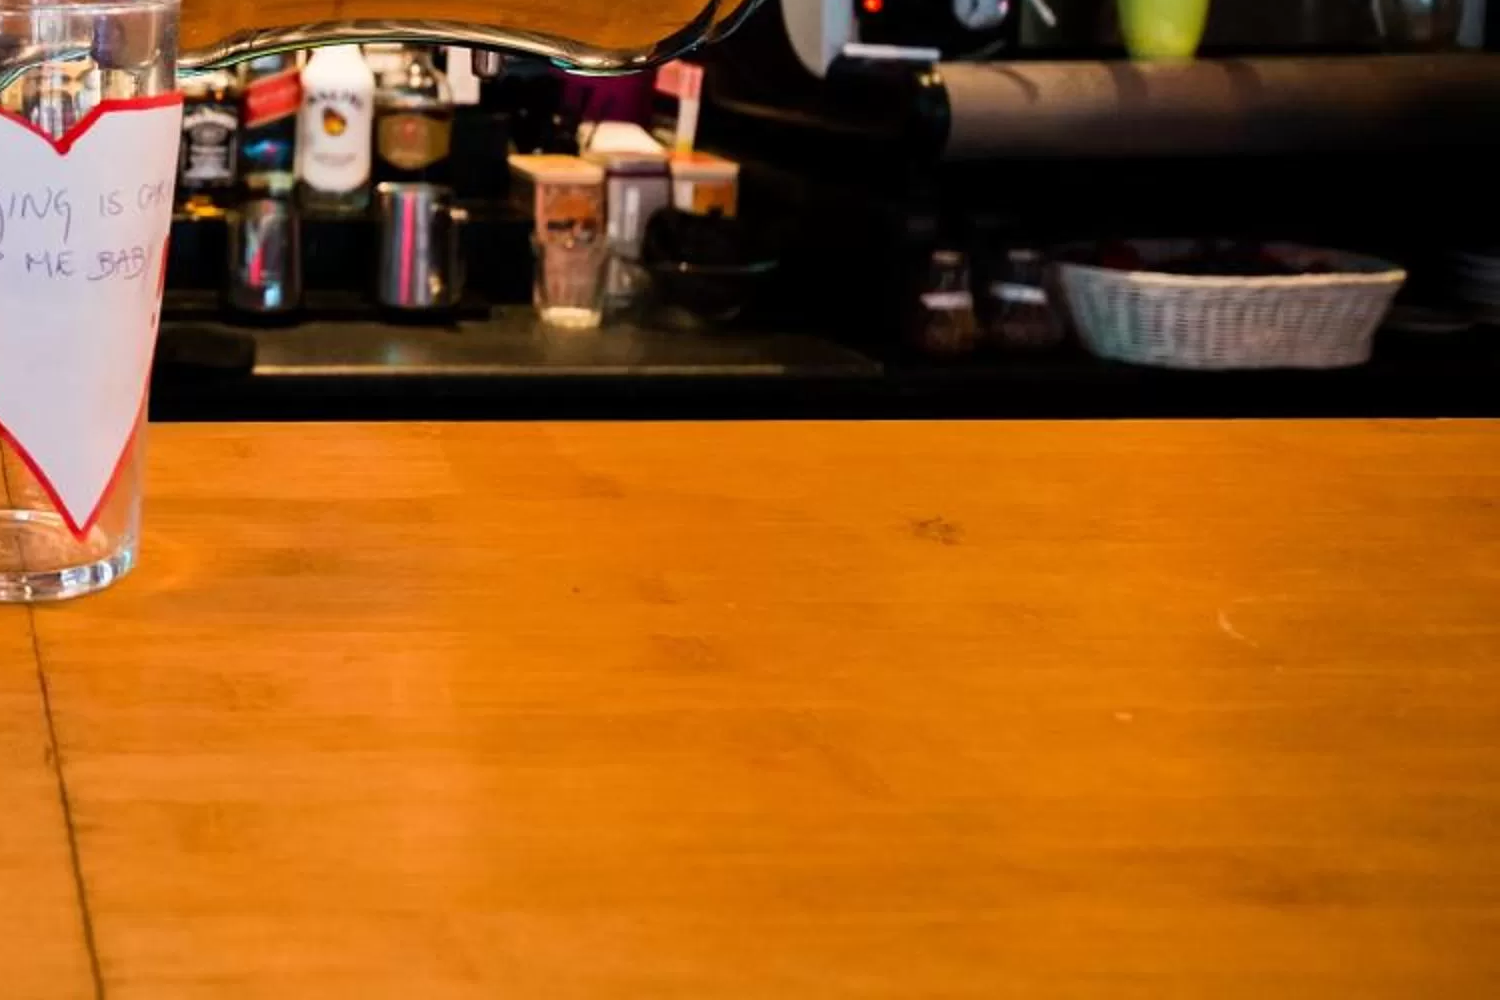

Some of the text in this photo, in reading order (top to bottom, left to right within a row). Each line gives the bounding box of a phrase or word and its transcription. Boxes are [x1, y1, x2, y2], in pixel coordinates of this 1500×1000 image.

[99, 190, 124, 217] IS
[25, 250, 74, 279] ME
[86, 245, 151, 281] BAB
